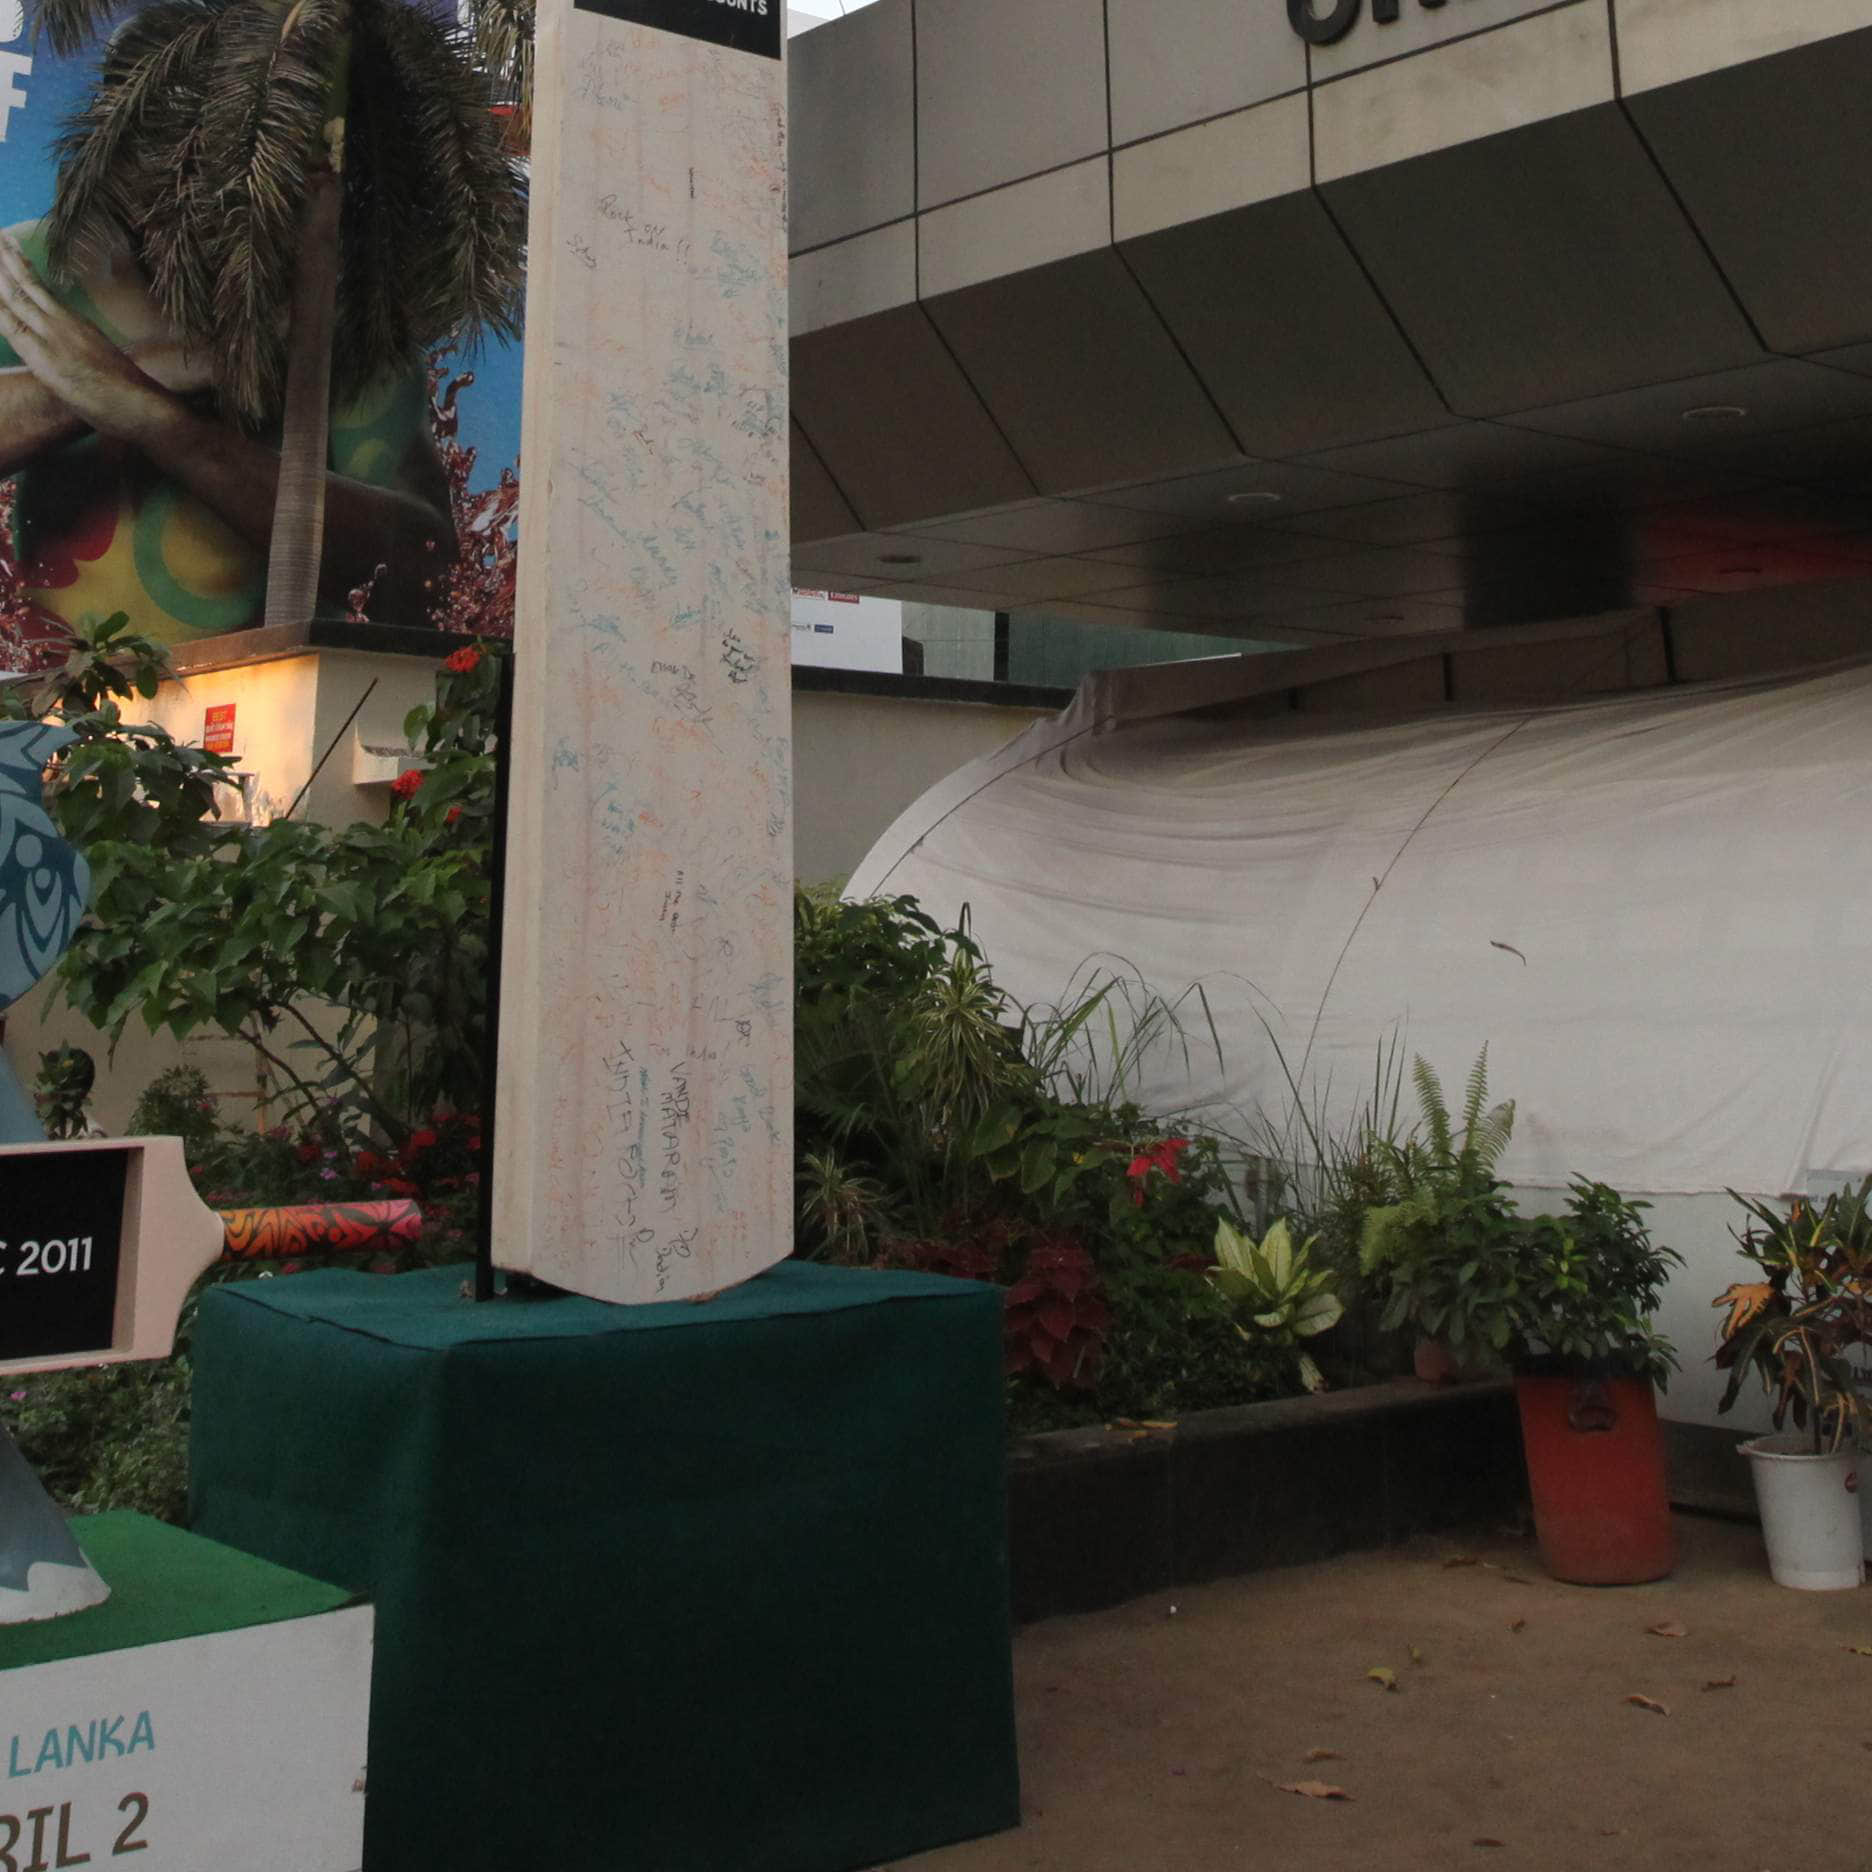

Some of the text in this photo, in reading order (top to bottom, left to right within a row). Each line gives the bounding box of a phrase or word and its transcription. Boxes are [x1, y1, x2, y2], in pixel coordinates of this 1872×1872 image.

[17, 1236, 94, 1276] 2011
[8, 1709, 156, 1779] LANKA
[112, 1791, 150, 1856] 2
